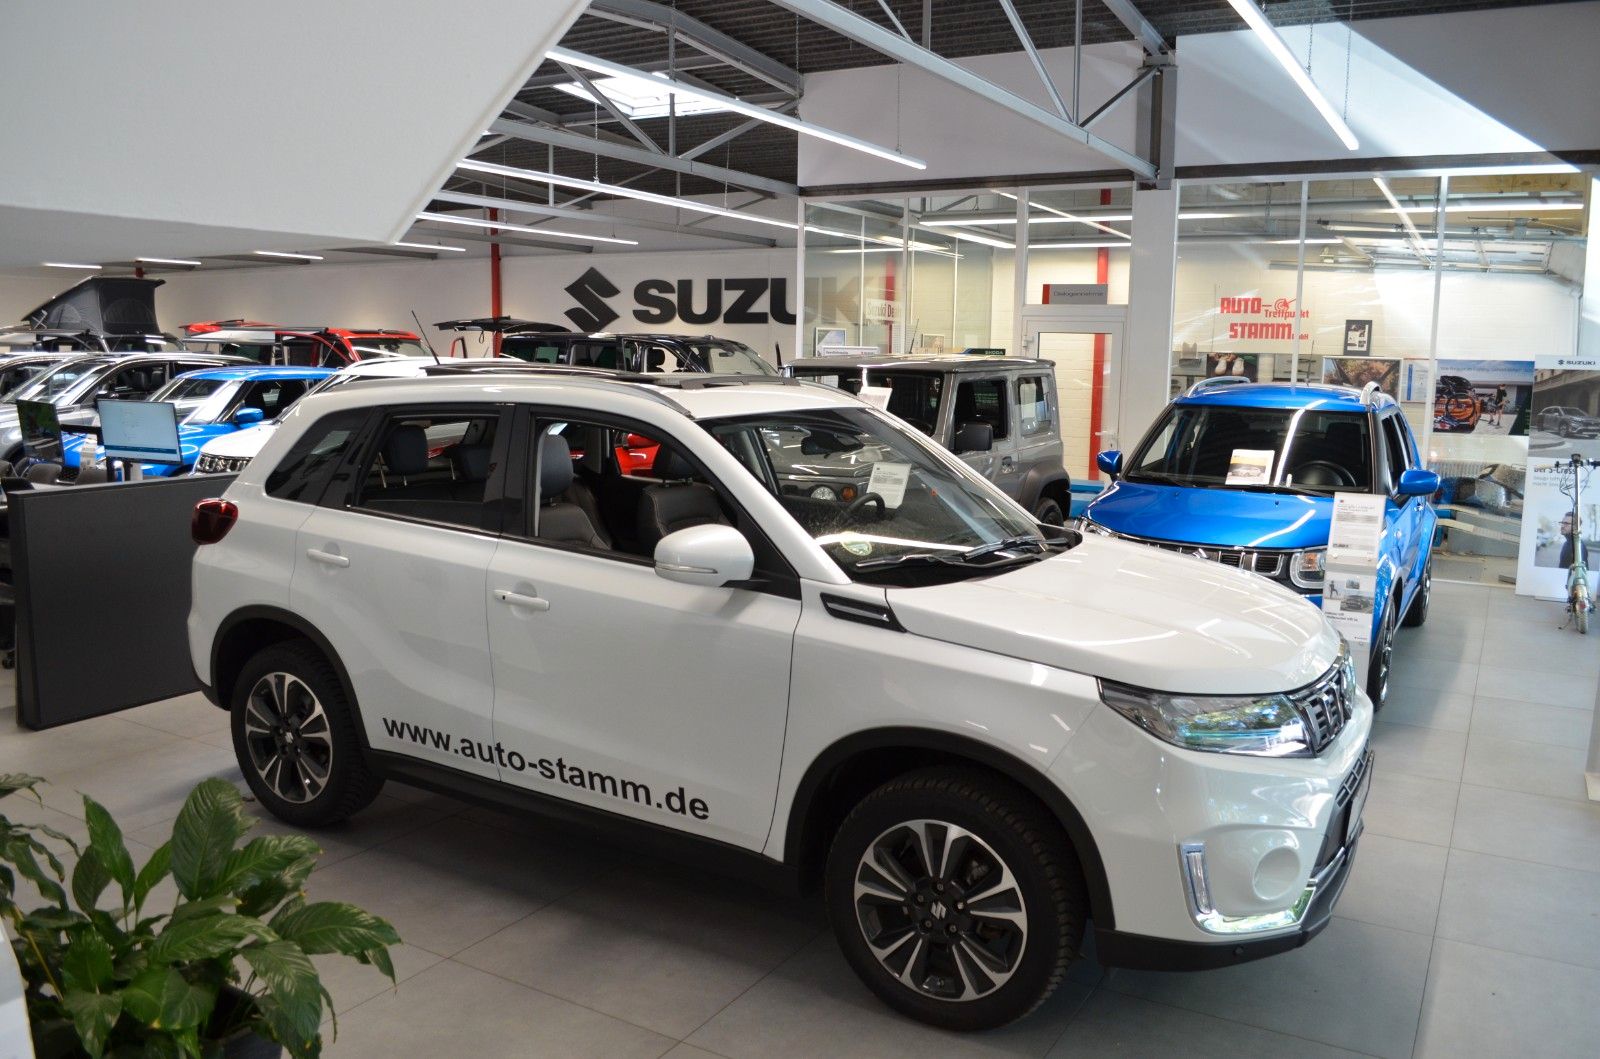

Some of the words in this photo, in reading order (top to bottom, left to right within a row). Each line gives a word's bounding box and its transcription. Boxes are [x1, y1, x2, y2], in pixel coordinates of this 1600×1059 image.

[1264, 309, 1309, 320] Treffpukt
[1229, 322, 1292, 340] STAMM
[382, 717, 709, 820] www.auto-stamm.de
